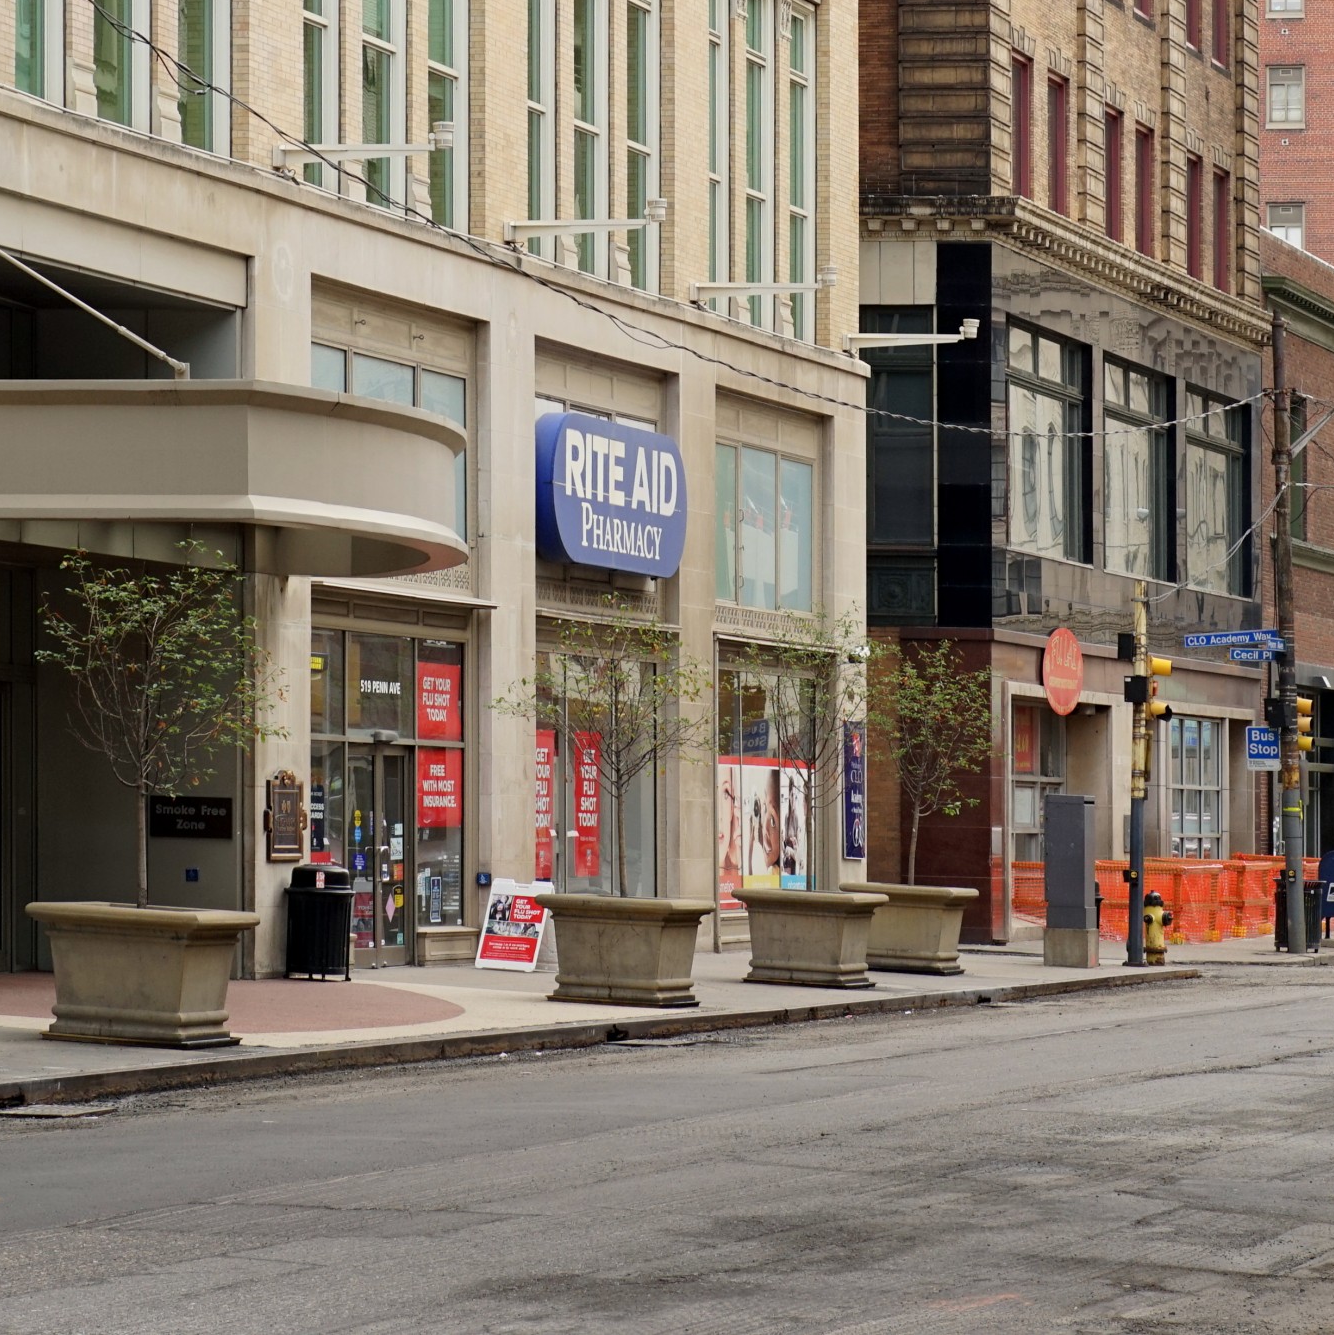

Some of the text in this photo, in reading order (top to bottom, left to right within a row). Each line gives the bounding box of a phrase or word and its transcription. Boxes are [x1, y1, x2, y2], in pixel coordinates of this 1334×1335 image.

[565, 427, 678, 517] RITE AID
[581, 501, 663, 561] PHARMACY
[1187, 632, 1272, 647] CLO Academy Way
[1233, 650, 1272, 660] Cecil Pl
[360, 679, 401, 695] 519 PENN AVE
[423, 676, 451, 692] GET YOUR
[422, 693, 451, 707] FLU SHOT
[426, 707, 447, 722] TODAY
[1251, 729, 1275, 742] Bus
[536, 748, 549, 762] GET
[583, 748, 595, 763] GET
[1249, 743, 1278, 756] Stop
[430, 764, 446, 777] FREE
[580, 765, 597, 780] YOUR
[422, 779, 455, 792] WITH MOST
[583, 781, 595, 795] FLU
[423, 795, 457, 808] INSURANCE.
[580, 797, 596, 812] SHOT
[155, 802, 227, 818] Smoke Free
[176, 817, 206, 832] Zone
[536, 813, 551, 828] ODAY
[578, 812, 597, 827] TODAY
